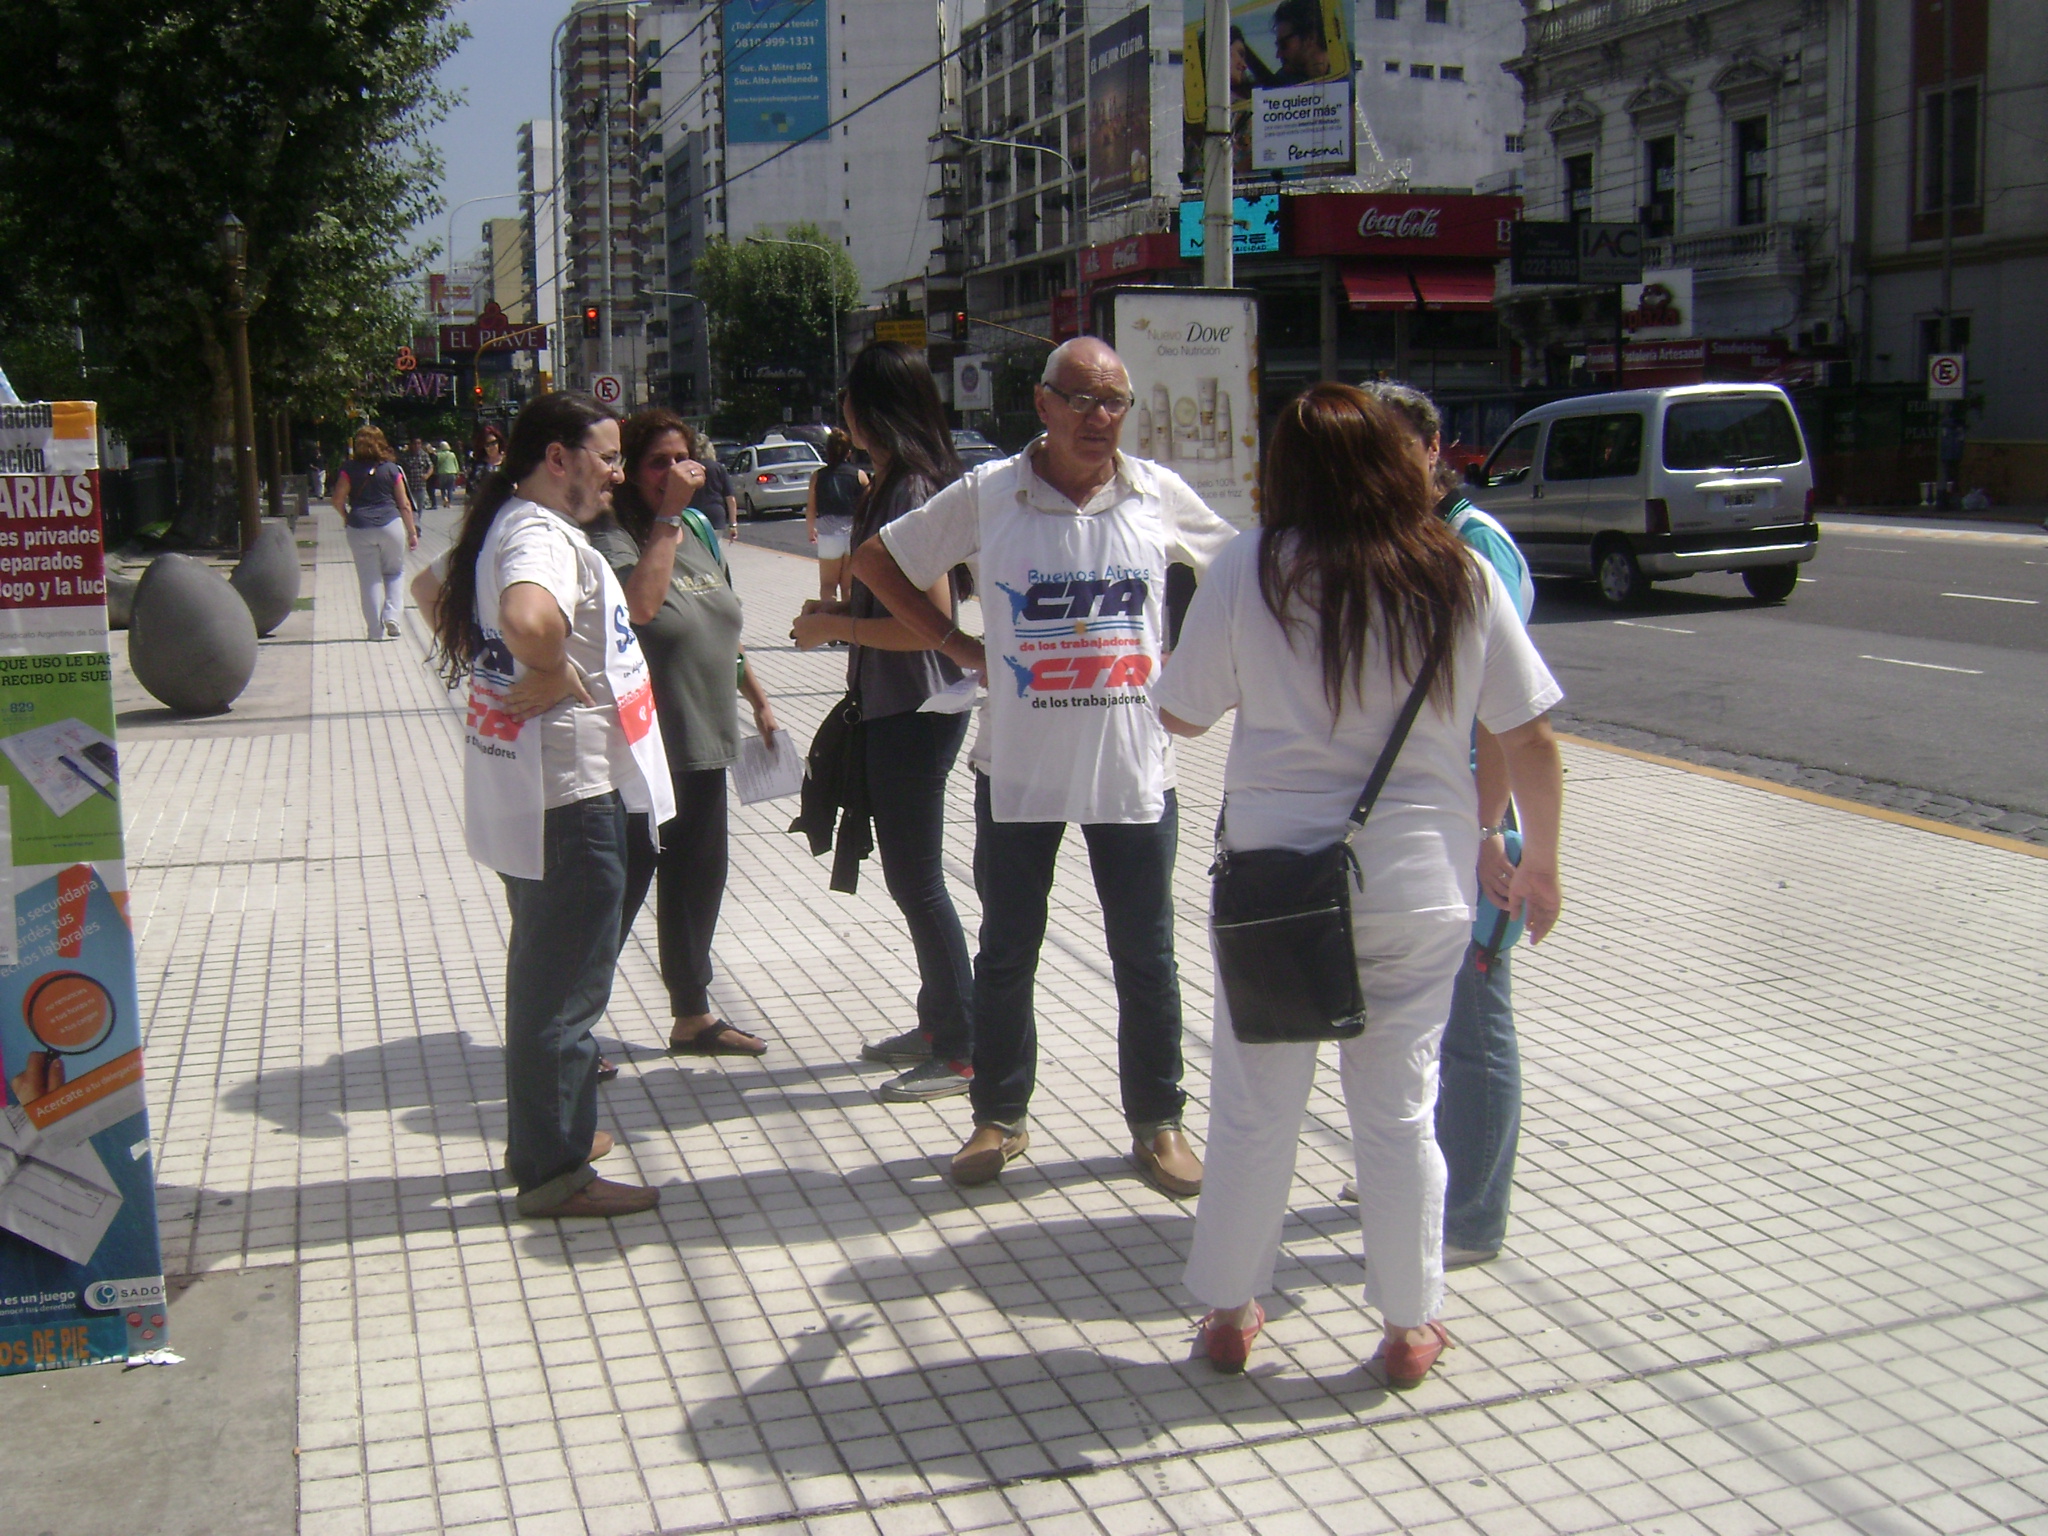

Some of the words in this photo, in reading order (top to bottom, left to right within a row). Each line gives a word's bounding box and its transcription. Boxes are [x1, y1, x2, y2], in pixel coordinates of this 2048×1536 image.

[1282, 94, 1321, 111] quiero
[1263, 108, 1311, 122] conocer
[1288, 139, 1344, 161] Personal
[1581, 228, 1639, 259] IAC
[449, 330, 473, 349] EL
[480, 329, 538, 348] PIAVE
[1147, 329, 1183, 341] Nuevo
[1185, 321, 1231, 343] Dove
[0, 474, 93, 519] ARIAS
[24, 525, 100, 551] privados
[0, 552, 83, 576] eparados
[1027, 569, 1097, 584] Buenos
[1104, 565, 1149, 580] Aires
[39, 580, 50, 601] y
[55, 576, 72, 596] la
[1021, 579, 1149, 621] CTA
[1019, 641, 1036, 652] de
[1038, 641, 1057, 651] los
[1060, 637, 1142, 650] trabajadores
[32, 656, 62, 669] USO
[66, 655, 83, 667] LE
[1028, 654, 1153, 692] CTA
[2, 673, 54, 686] RECIBO
[58, 671, 78, 683] DE
[10, 702, 35, 713] 829
[1032, 697, 1047, 709] de
[1050, 696, 1068, 708] los
[1072, 693, 1147, 708] trabajadores
[27, 879, 99, 922] secundaria
[16, 925, 52, 950] erdés
[52, 913, 75, 930] tus
[39, 920, 101, 958] laborales
[36, 1086, 84, 1118] Acercate
[21, 1294, 37, 1304] un
[39, 1290, 76, 1304] juego
[25, 1304, 39, 1314] tus
[39, 1302, 77, 1313] derechos
[32, 1328, 57, 1364] DE
[60, 1325, 90, 1362] PIE
